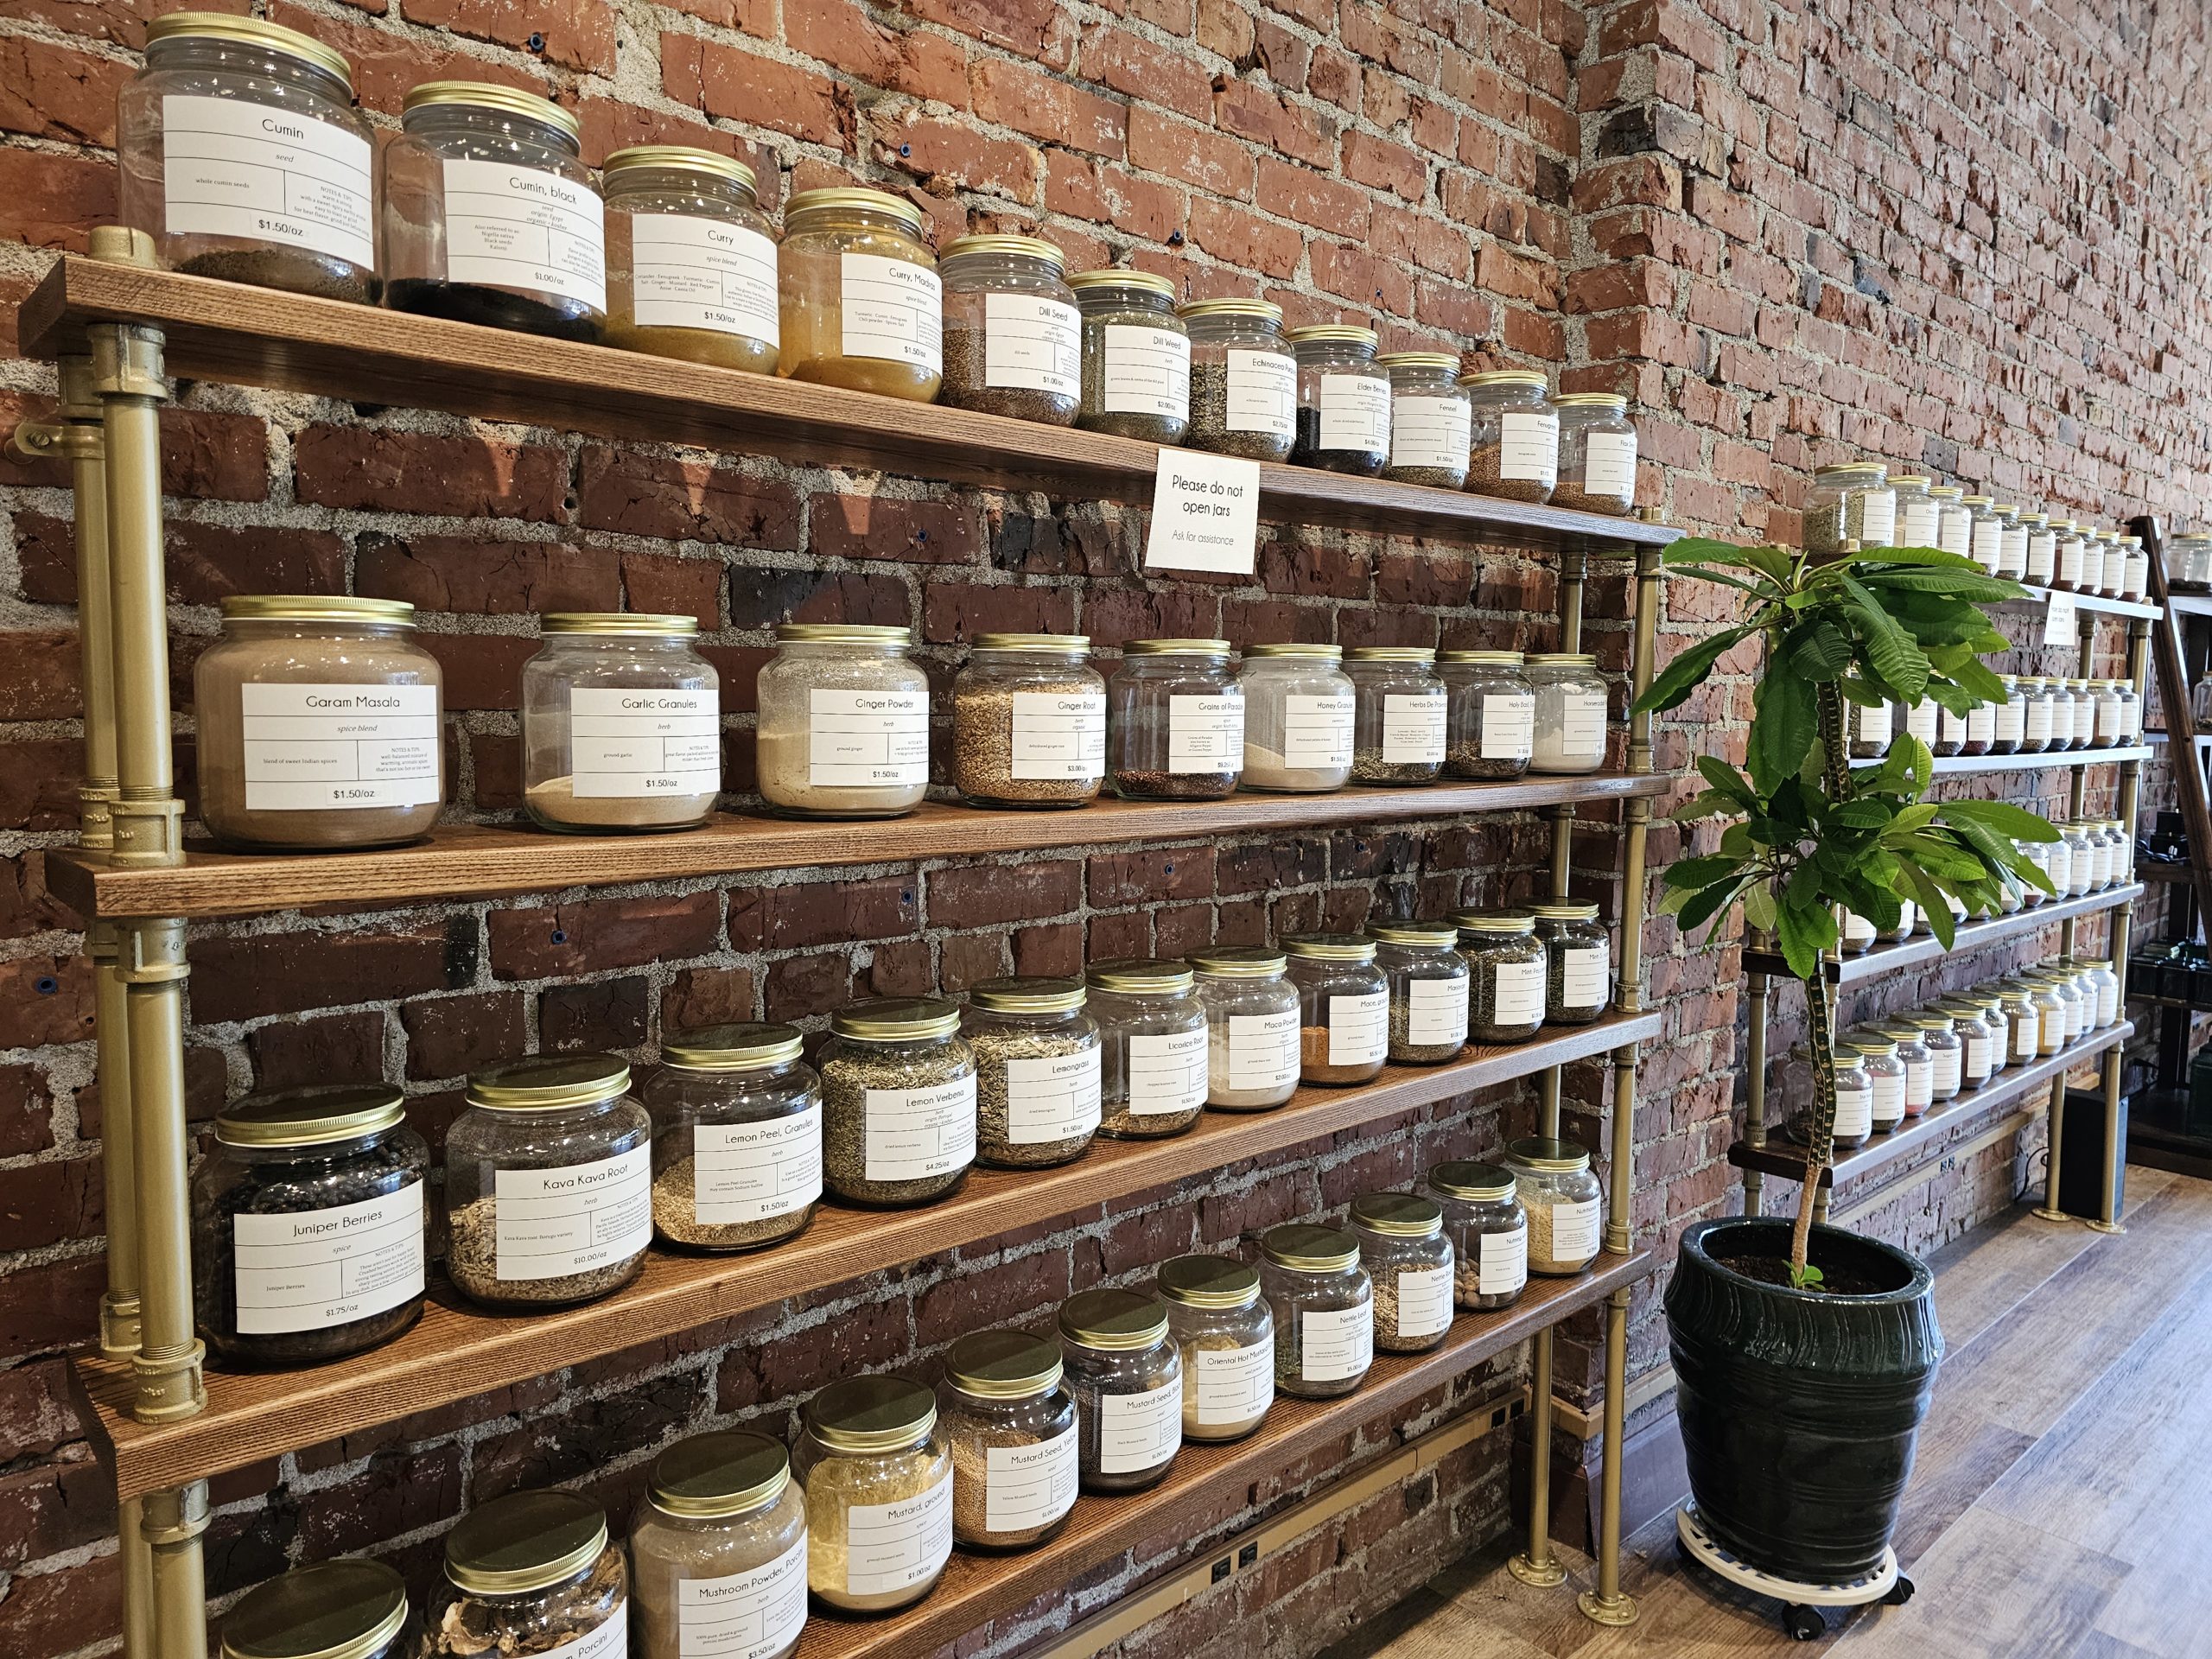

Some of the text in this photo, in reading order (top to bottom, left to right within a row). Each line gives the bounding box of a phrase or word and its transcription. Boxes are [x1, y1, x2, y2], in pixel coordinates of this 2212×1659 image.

[262, 119, 304, 139] Cumin
[276, 154, 294, 162] seed
[510, 177, 577, 205] Cumin, black
[550, 213, 563, 222] Egypt
[258, 219, 303, 238] $1.50/oz
[708, 230, 734, 245] Curry
[706, 255, 738, 266] spice blend
[535, 272, 564, 285] $1.00/oz
[889, 268, 935, 291] Curry, Madras
[704, 311, 735, 323] $1.50/oz
[1039, 307, 1068, 321] Dill Seed
[1153, 336, 1181, 350] Dill Weed
[904, 346, 926, 358] $1.50/oz
[1252, 359, 1284, 371] Echinacea
[1043, 376, 1064, 387] $1.00/oz
[1357, 383, 1372, 391] Elder
[1173, 475, 1243, 498] Please do not
[1183, 502, 1230, 517] open jars
[1172, 530, 1234, 545] Ask for assistance
[306, 696, 400, 708] Garam Masala
[621, 698, 697, 709] Garlic Granules
[855, 698, 914, 709] Ginger Powder
[1058, 701, 1081, 710] Ginger
[334, 789, 375, 799] $1.50/oz
[1168, 1037, 1203, 1050] Licorice Root
[1052, 1060, 1090, 1074] Lemongrass
[906, 1090, 964, 1107] Lemon Verbena
[725, 1119, 813, 1144] Lemon Peel, Granules
[925, 1160, 950, 1171] $4.25/oz
[543, 1165, 628, 1191] Kava Kava Root
[584, 1197, 598, 1205] herb
[760, 1200, 789, 1212] $1.50/oz
[293, 1210, 383, 1237] Juniper Berries
[332, 1243, 352, 1255] spice
[574, 1251, 607, 1265] $10.00/oz
[326, 1304, 359, 1317] $1.75/oz
[1339, 1310, 1367, 1325] Nettle Leaf
[1208, 1357, 1236, 1365] Oriental
[1250, 1347, 1268, 1359] Mustard
[1128, 1397, 1155, 1409] Mustard
[1156, 1391, 1171, 1402] Seed,
[1011, 1452, 1043, 1465] Mustard
[1045, 1444, 1062, 1458] Seed,
[888, 1486, 945, 1520] Mustard, ground
[907, 1565, 931, 1580] $1.00/oz
[699, 1583, 748, 1599] Mushroom
[751, 1567, 784, 1588] Powder,
[579, 1632, 607, 1657] Porcini
[748, 1643, 776, 1659] $3.50/oz
